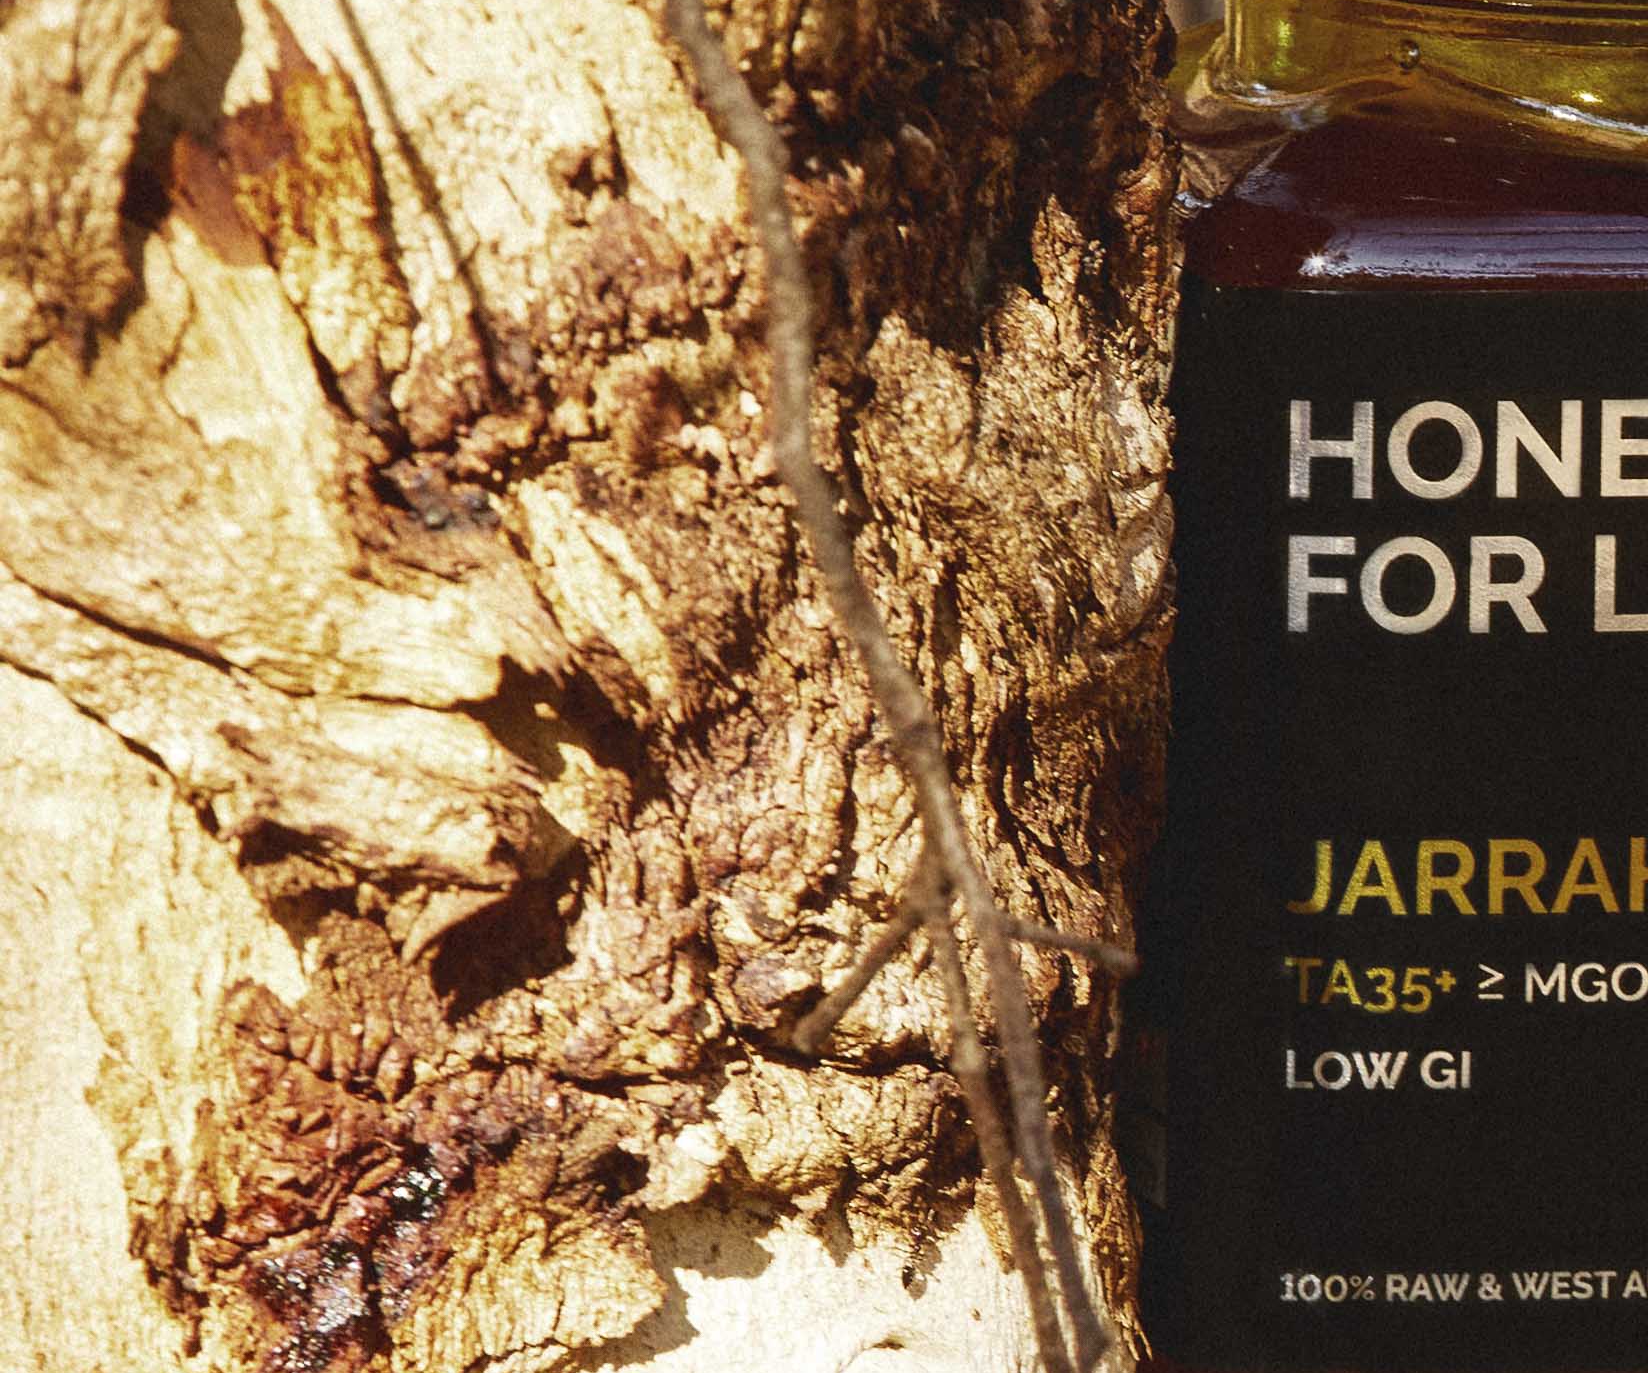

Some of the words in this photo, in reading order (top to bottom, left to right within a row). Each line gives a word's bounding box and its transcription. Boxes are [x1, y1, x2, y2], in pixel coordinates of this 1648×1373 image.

[1287, 534, 1548, 634] FOR
[1284, 956, 1457, 1014] TA35+
[1285, 1049, 1409, 1090] LOW
[1420, 1050, 1472, 1090] GI
[1280, 1273, 1376, 1302] 100%
[1385, 1273, 1470, 1302] RAW
[1477, 1274, 1504, 1302] &
[1511, 1271, 1617, 1301] WEST
